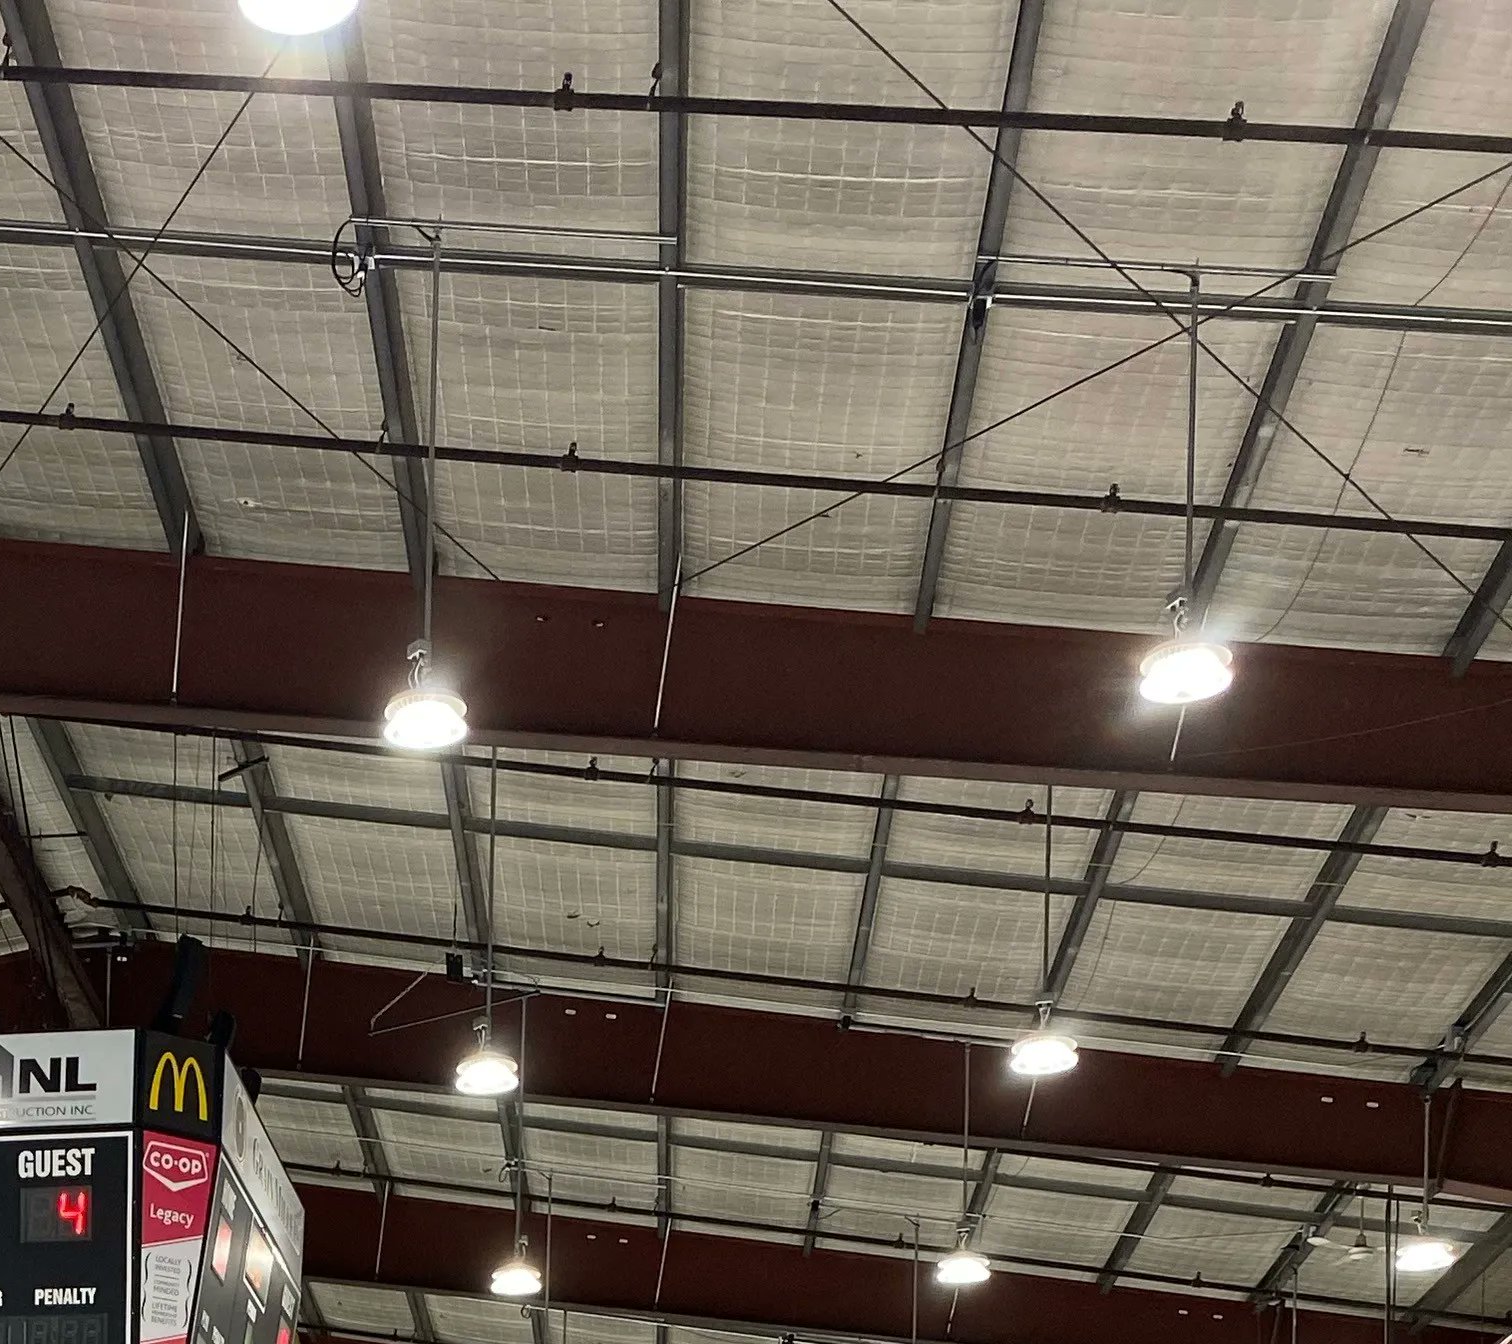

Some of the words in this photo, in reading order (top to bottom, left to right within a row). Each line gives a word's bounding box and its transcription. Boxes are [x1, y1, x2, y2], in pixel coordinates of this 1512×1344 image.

[18, 1148, 95, 1178] GUEST
[58, 1190, 86, 1236] 4
[149, 1203, 195, 1229] Legacy
[34, 1287, 97, 1306] PENALTY
